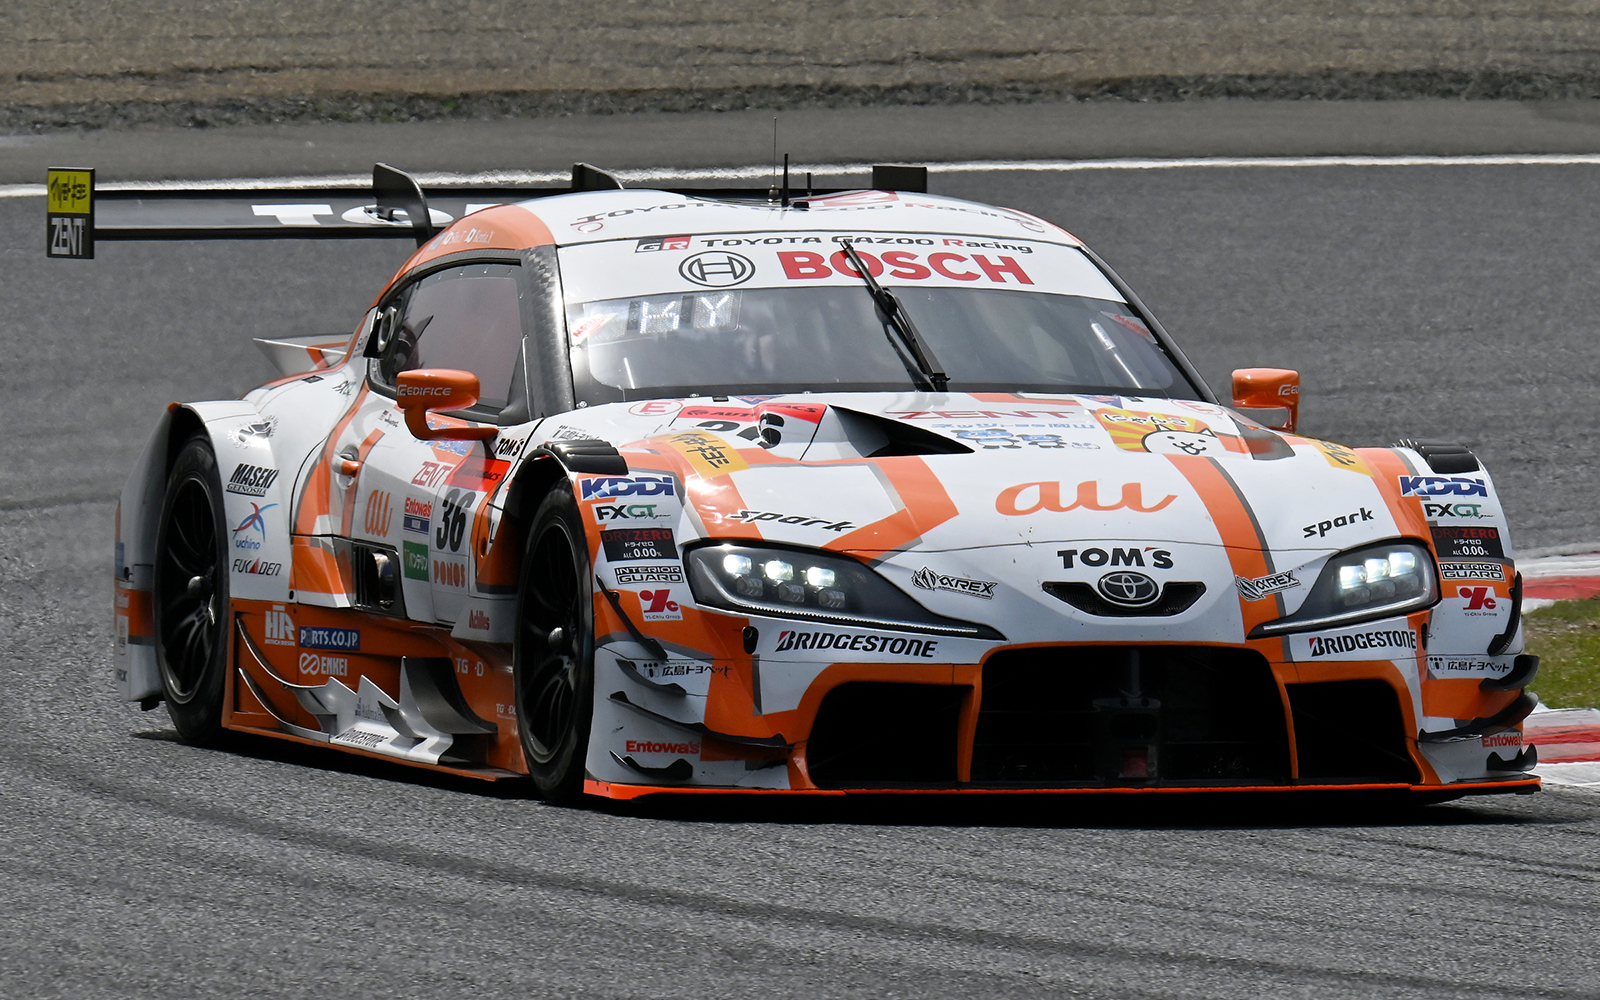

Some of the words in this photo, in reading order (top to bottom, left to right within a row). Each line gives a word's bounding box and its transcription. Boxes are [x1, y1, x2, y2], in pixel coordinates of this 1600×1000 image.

[51, 217, 86, 255] ZENT
[700, 236, 821, 247] TOYOTA
[831, 235, 934, 246] GAZOO
[942, 238, 1033, 254] Racing
[777, 250, 1035, 285] BOSCH
[407, 387, 452, 396] EDIFICE
[710, 403, 819, 417] AUTACS
[885, 410, 1075, 420] ZENT
[495, 437, 525, 457] TOM'S
[229, 462, 279, 489] MASEKI
[411, 461, 453, 488] ZENT
[581, 476, 674, 500] KDDI
[1400, 476, 1488, 497] KDDI
[995, 480, 1178, 516] au
[365, 490, 393, 537] au
[436, 488, 477, 552] 36
[724, 510, 857, 532] spark
[1302, 507, 1374, 538] spark
[1057, 547, 1174, 569] TOM'S
[1440, 563, 1502, 572] INTERIOR
[434, 560, 466, 588] PONOS
[616, 567, 681, 575] INTERIOR
[619, 574, 682, 583] GUARD
[1444, 571, 1503, 580] GUARD
[775, 630, 939, 658] BRIDGESTONE
[1308, 630, 1417, 657] BRIDGESTONE
[321, 656, 348, 676] ENKEI
[1447, 661, 1510, 673] 広島トヨペット
[626, 740, 700, 755] Entowa's
